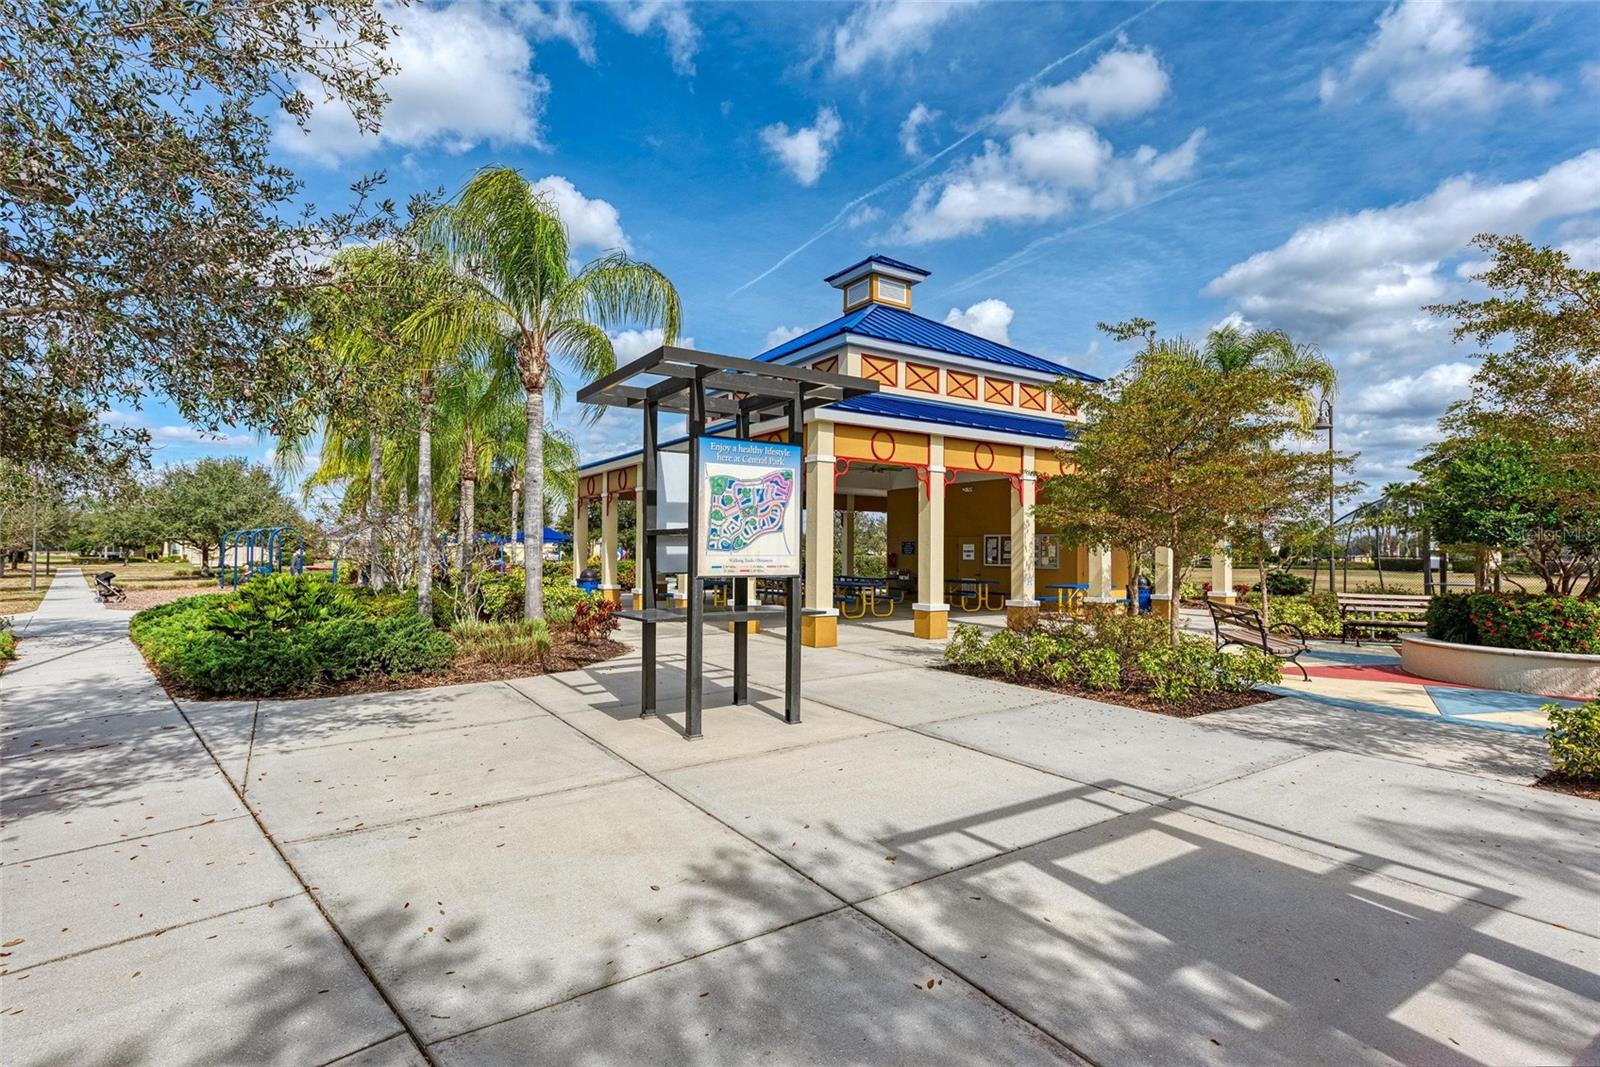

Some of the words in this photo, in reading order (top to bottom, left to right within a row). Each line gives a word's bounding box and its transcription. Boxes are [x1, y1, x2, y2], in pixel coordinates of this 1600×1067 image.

[710, 442, 730, 453] Enjoy
[738, 444, 764, 456] healthy
[765, 446, 791, 457] lifestyle
[716, 453, 732, 461] here
[742, 455, 767, 464] Central
[768, 457, 785, 465] Park
